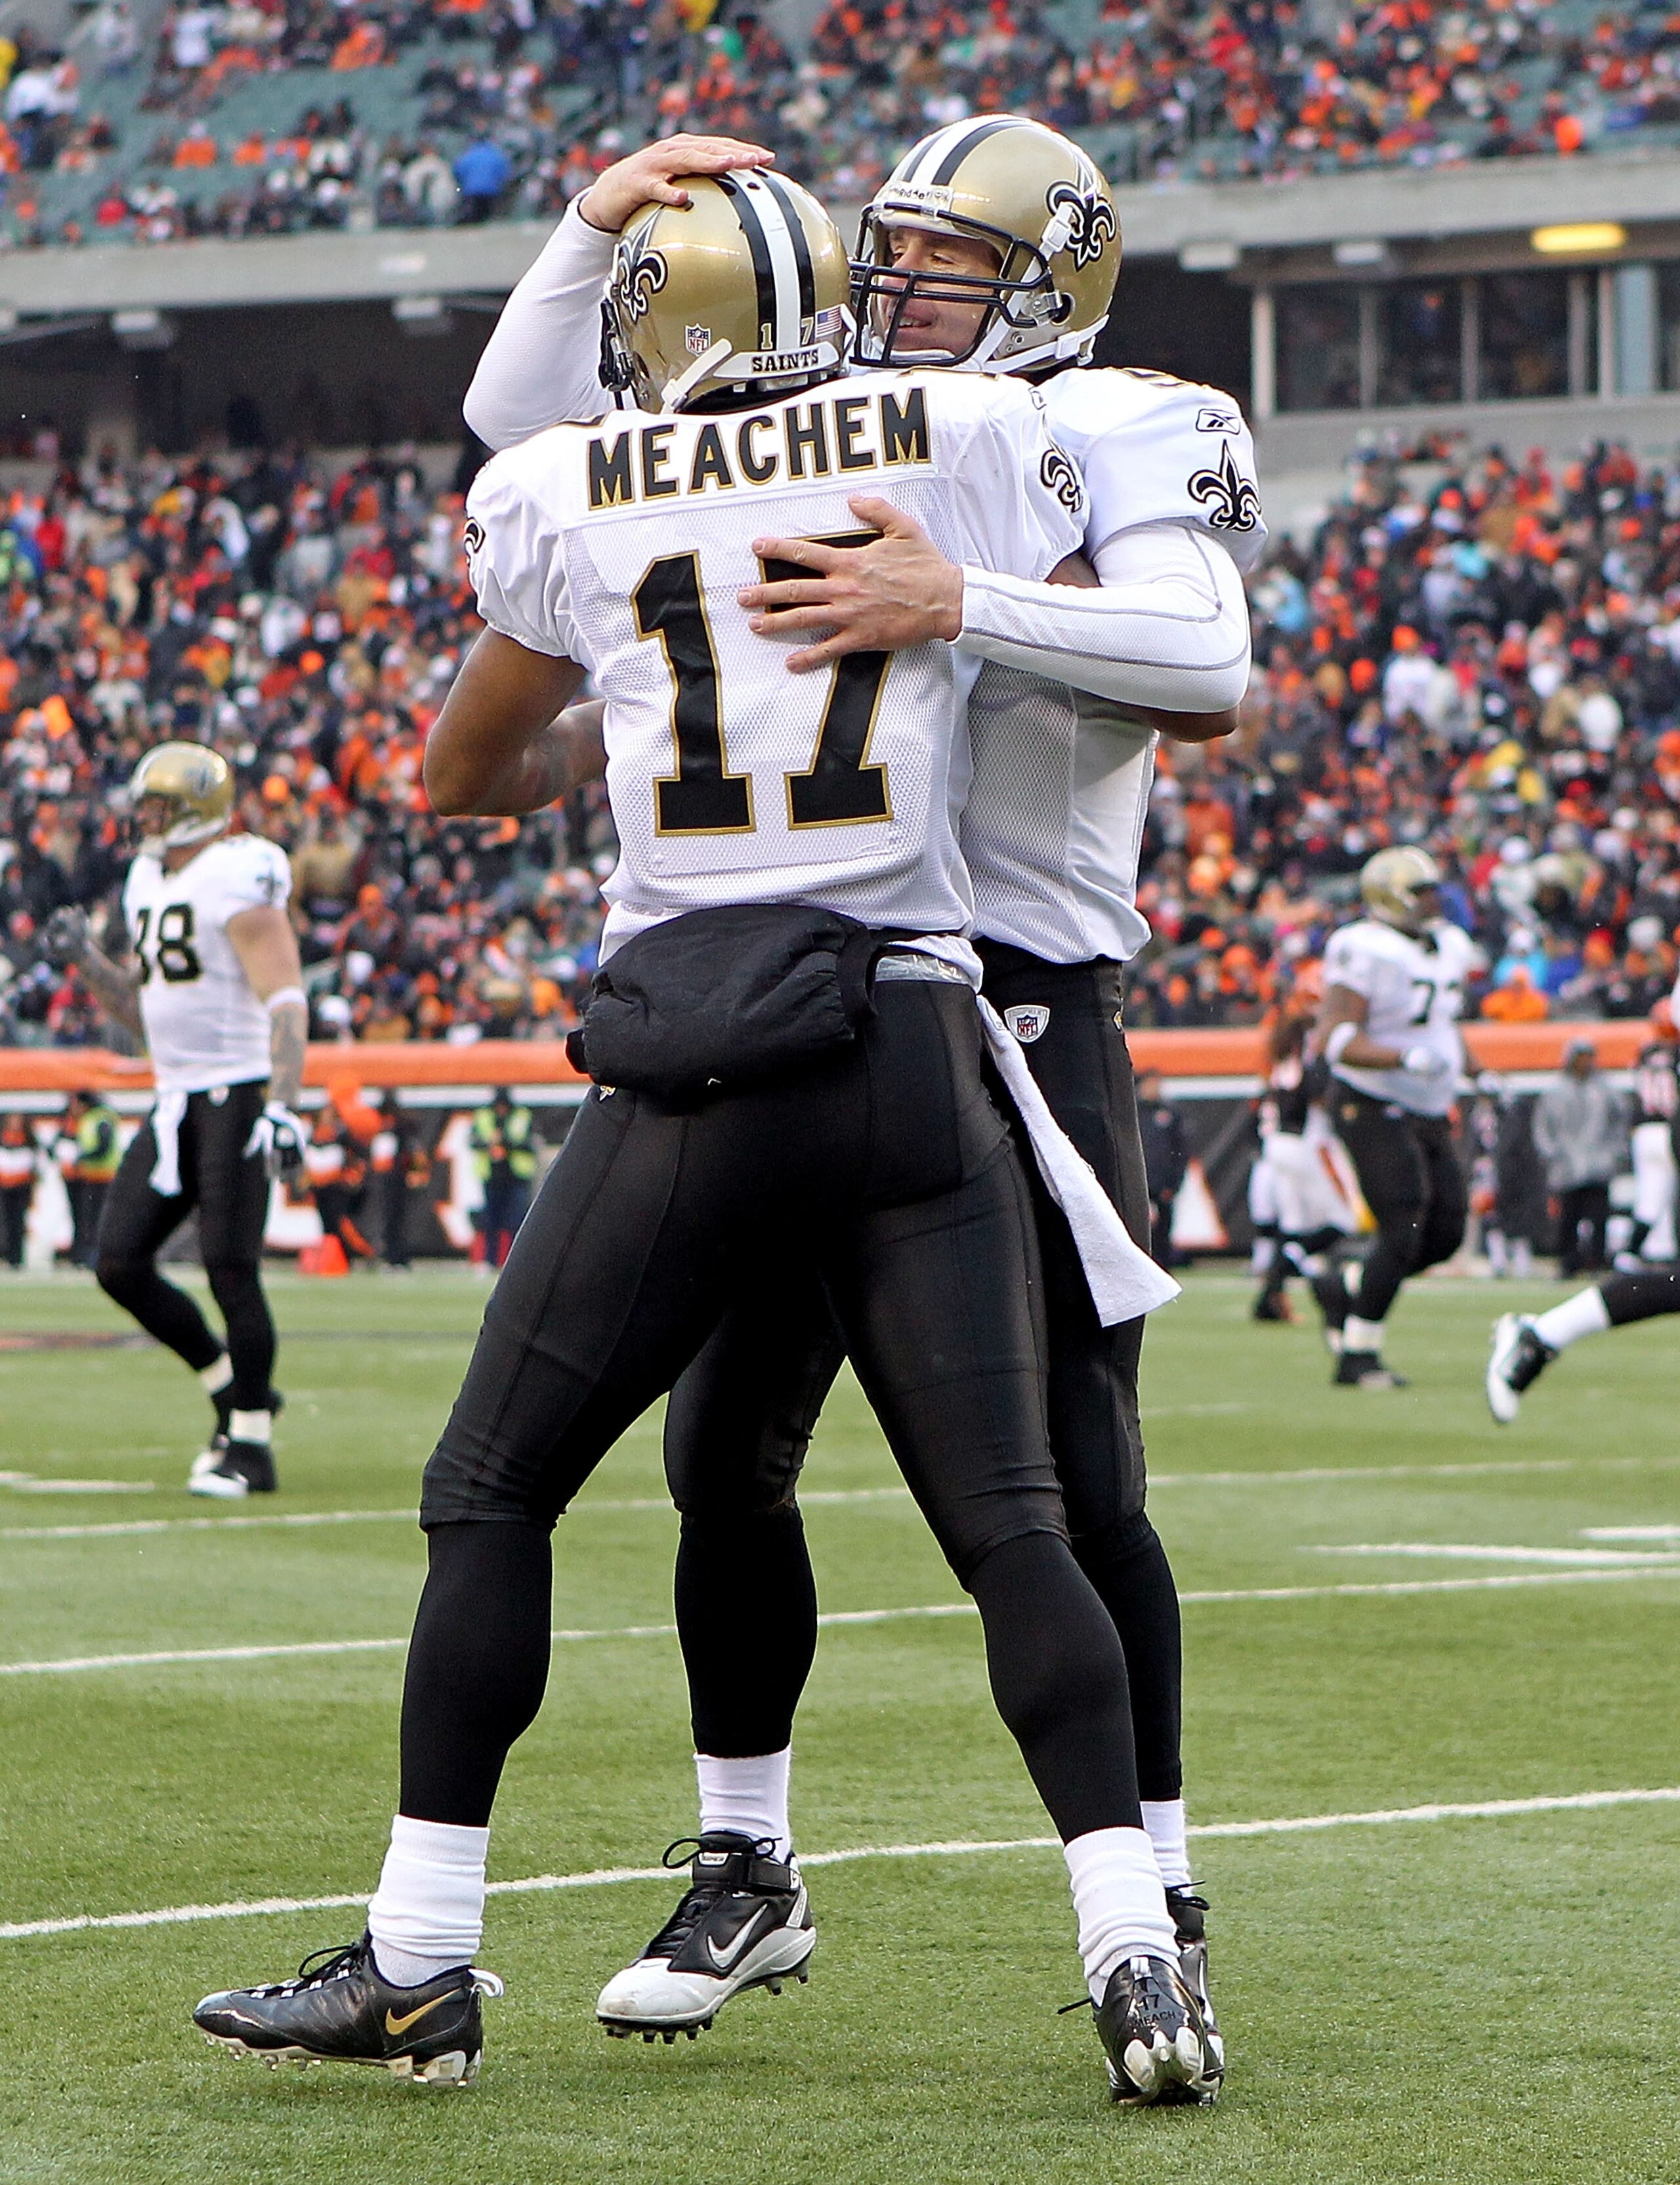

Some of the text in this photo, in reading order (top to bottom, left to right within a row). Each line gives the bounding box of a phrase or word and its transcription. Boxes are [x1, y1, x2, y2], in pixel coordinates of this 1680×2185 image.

[689, 337, 707, 351] NFL
[753, 349, 819, 372] SAINTS
[587, 386, 933, 511] MEACHEM
[630, 528, 894, 837] 17
[1018, 1025, 1038, 1036] NFL
[1139, 1993, 1160, 2010] 17
